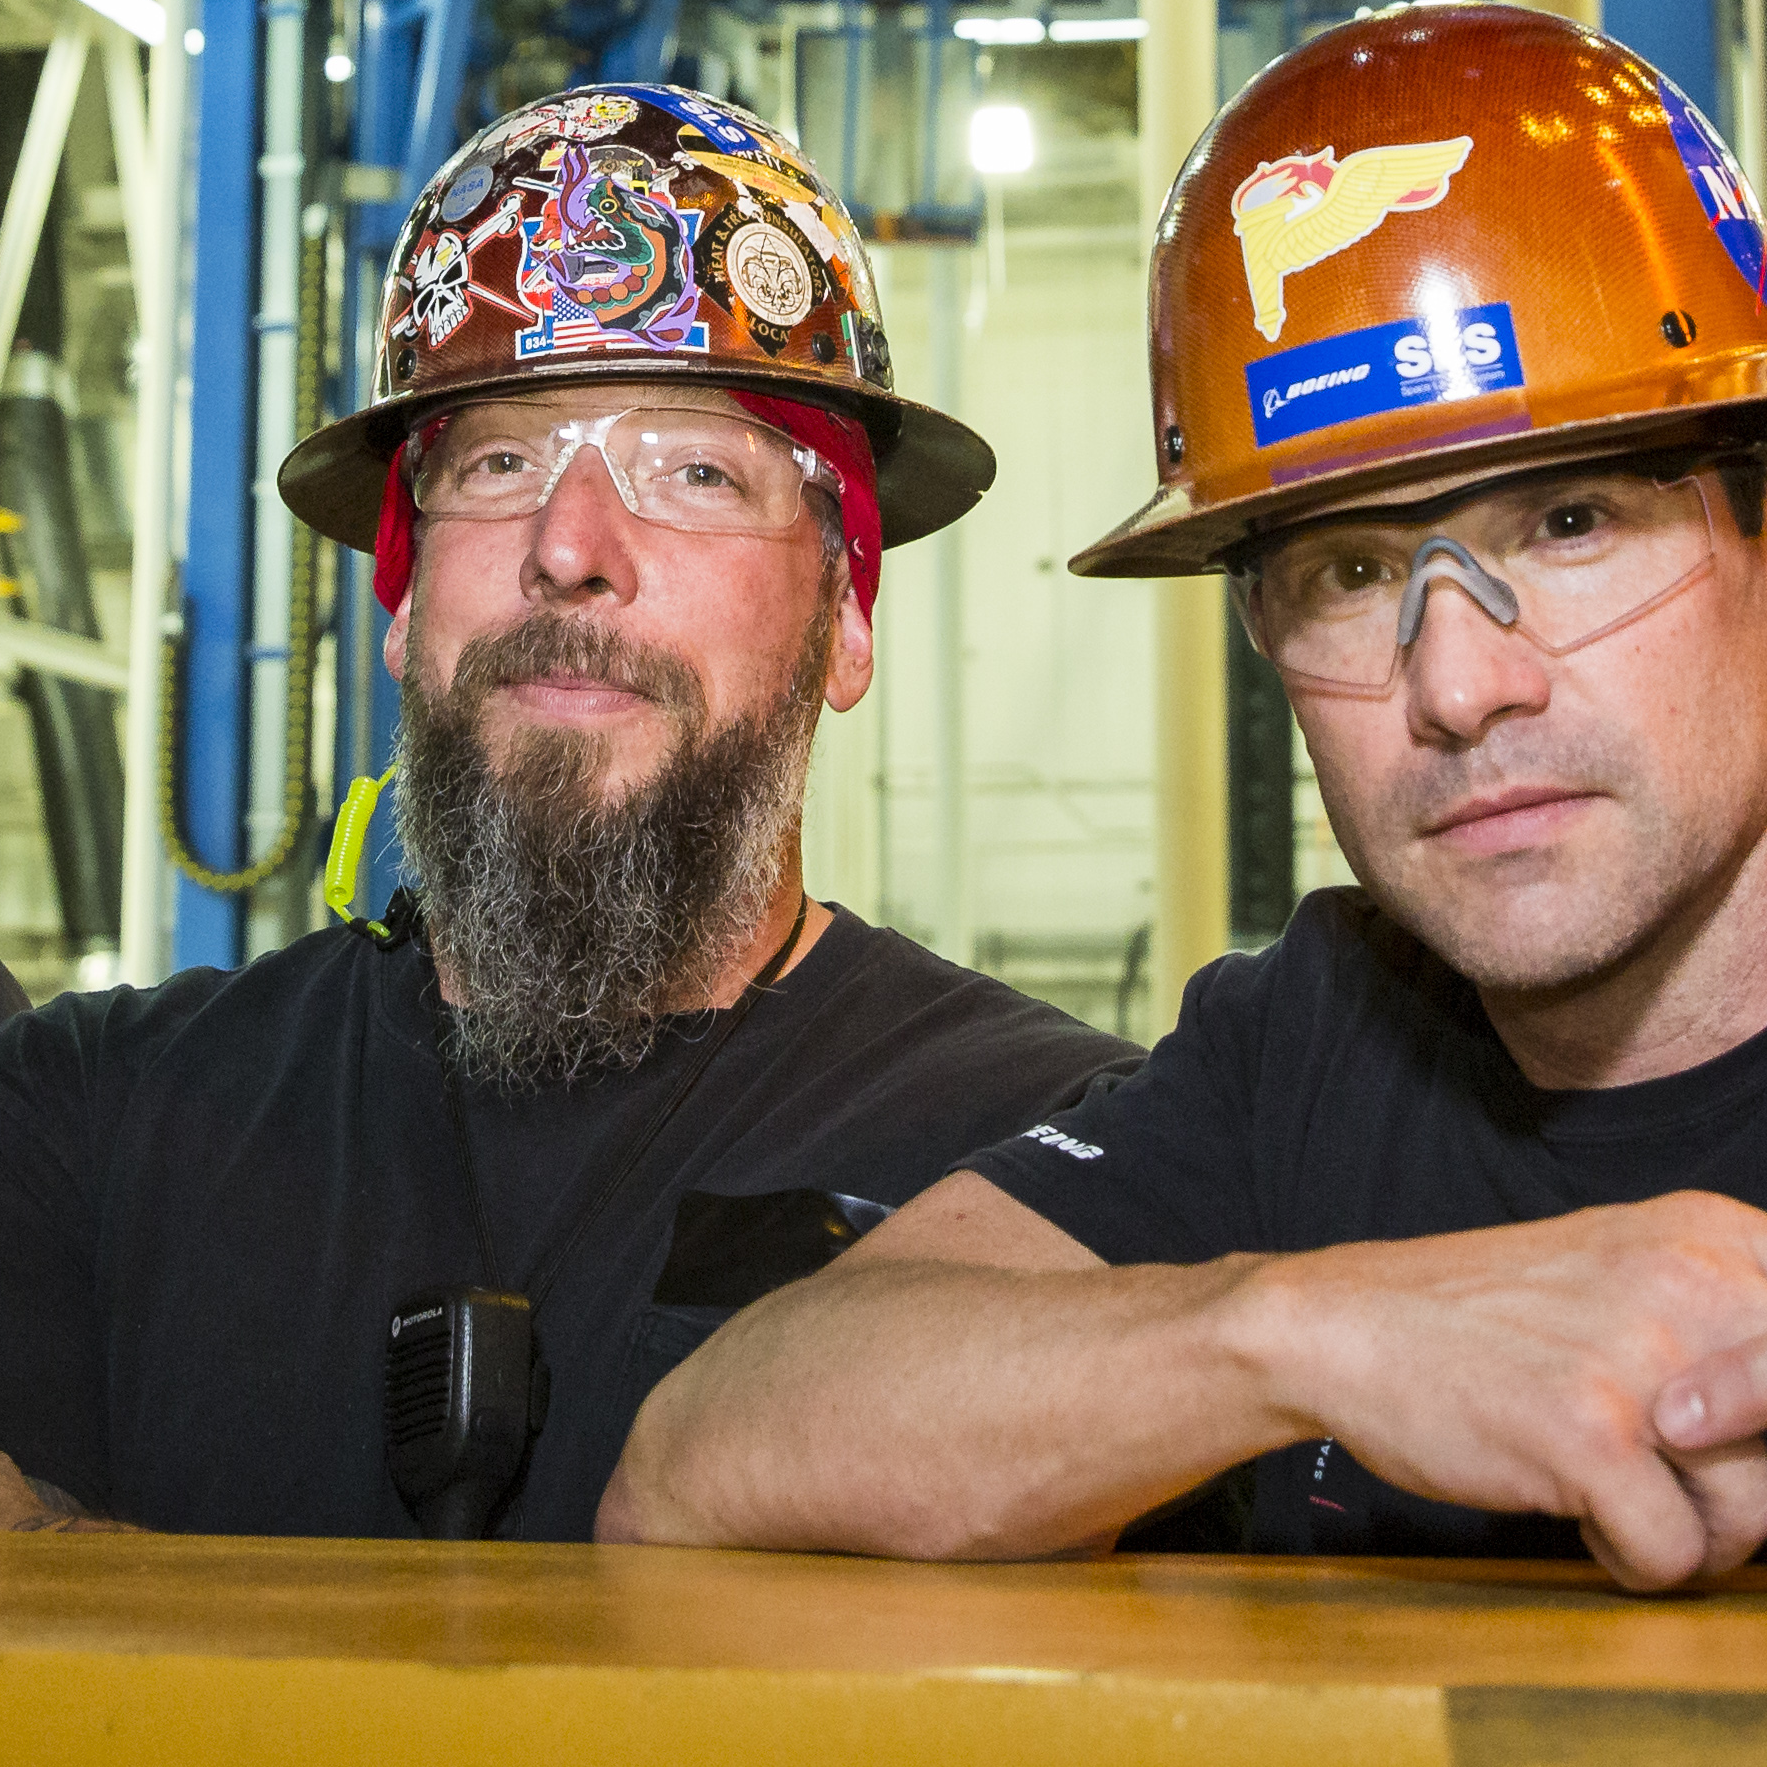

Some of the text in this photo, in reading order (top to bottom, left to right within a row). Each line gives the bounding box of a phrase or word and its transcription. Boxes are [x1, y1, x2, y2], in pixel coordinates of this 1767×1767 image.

[679, 101, 747, 143] SLS
[451, 178, 484, 198] NASA
[1394, 322, 1502, 378] SS
[1285, 363, 1371, 400] BOEING
[403, 1307, 442, 1326] MOTOROLA
